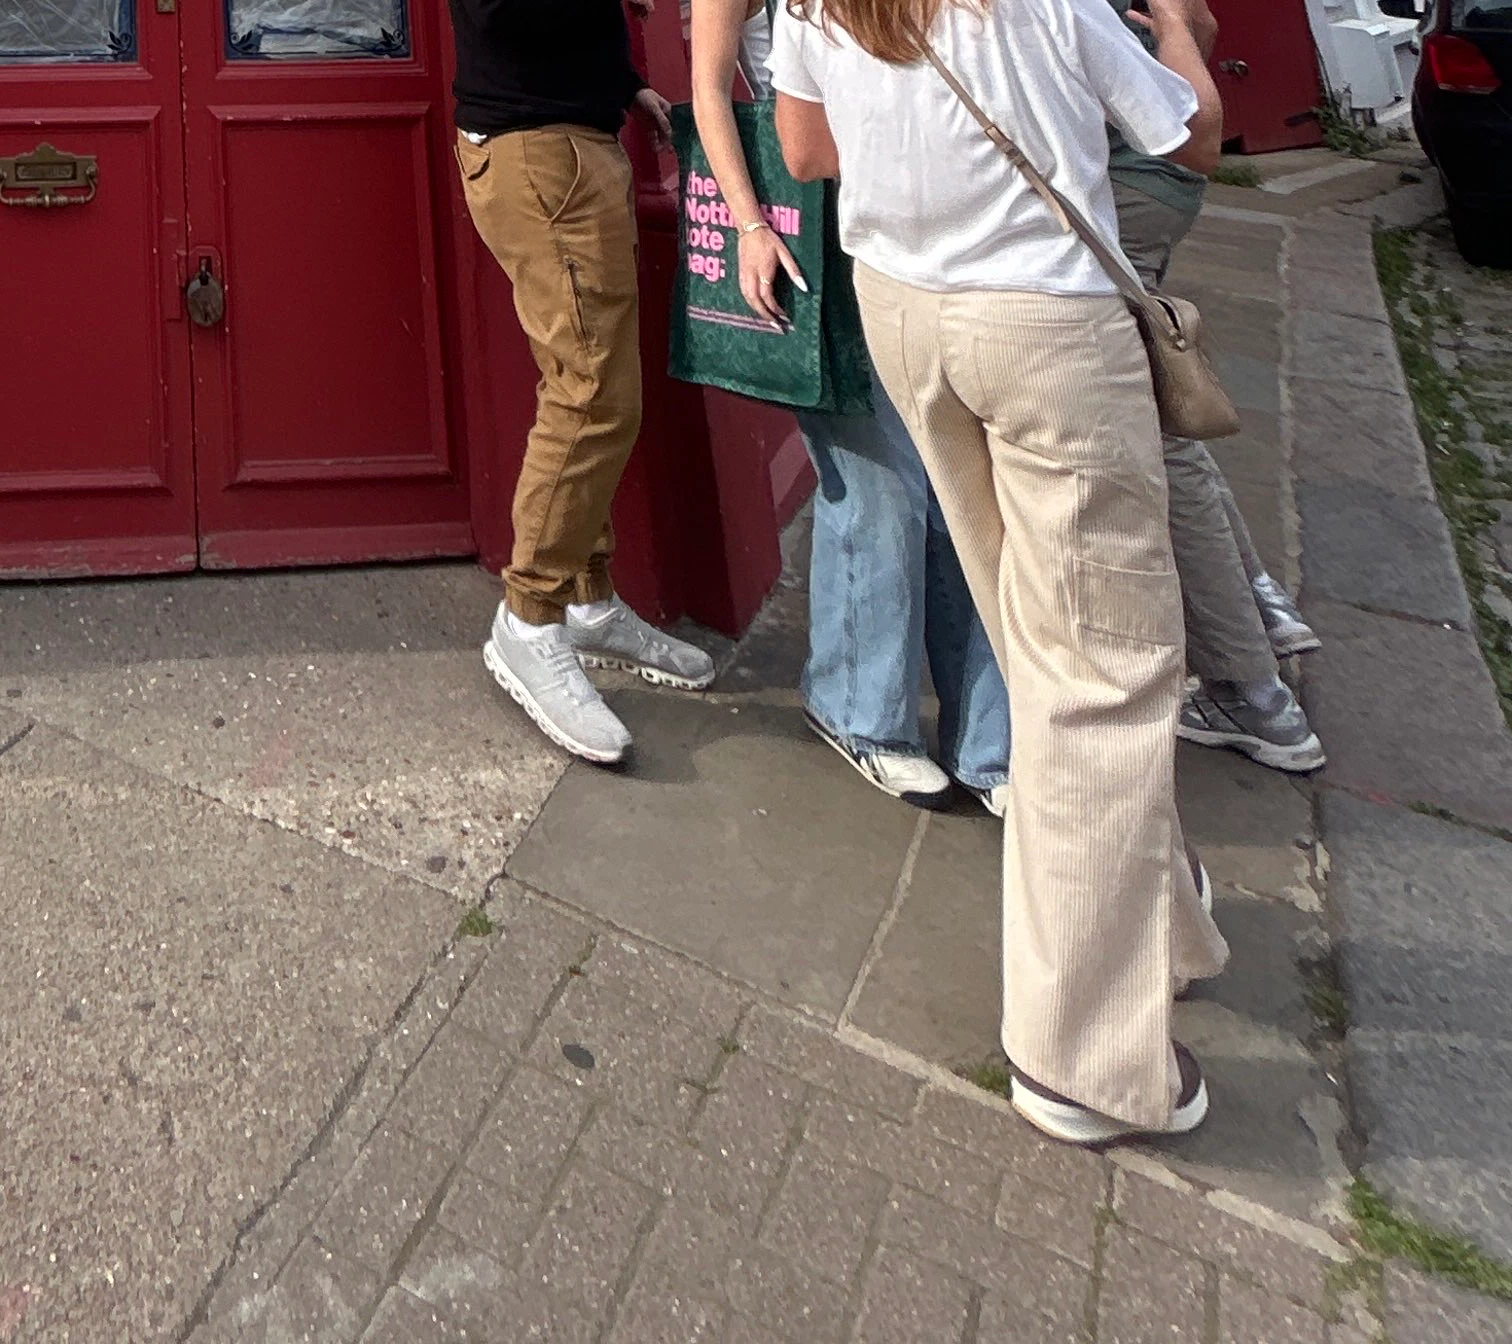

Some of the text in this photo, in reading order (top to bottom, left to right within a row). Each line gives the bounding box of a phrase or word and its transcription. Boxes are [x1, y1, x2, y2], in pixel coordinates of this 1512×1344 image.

[686, 196, 800, 236] Notti Hill
[688, 224, 725, 252] ote
